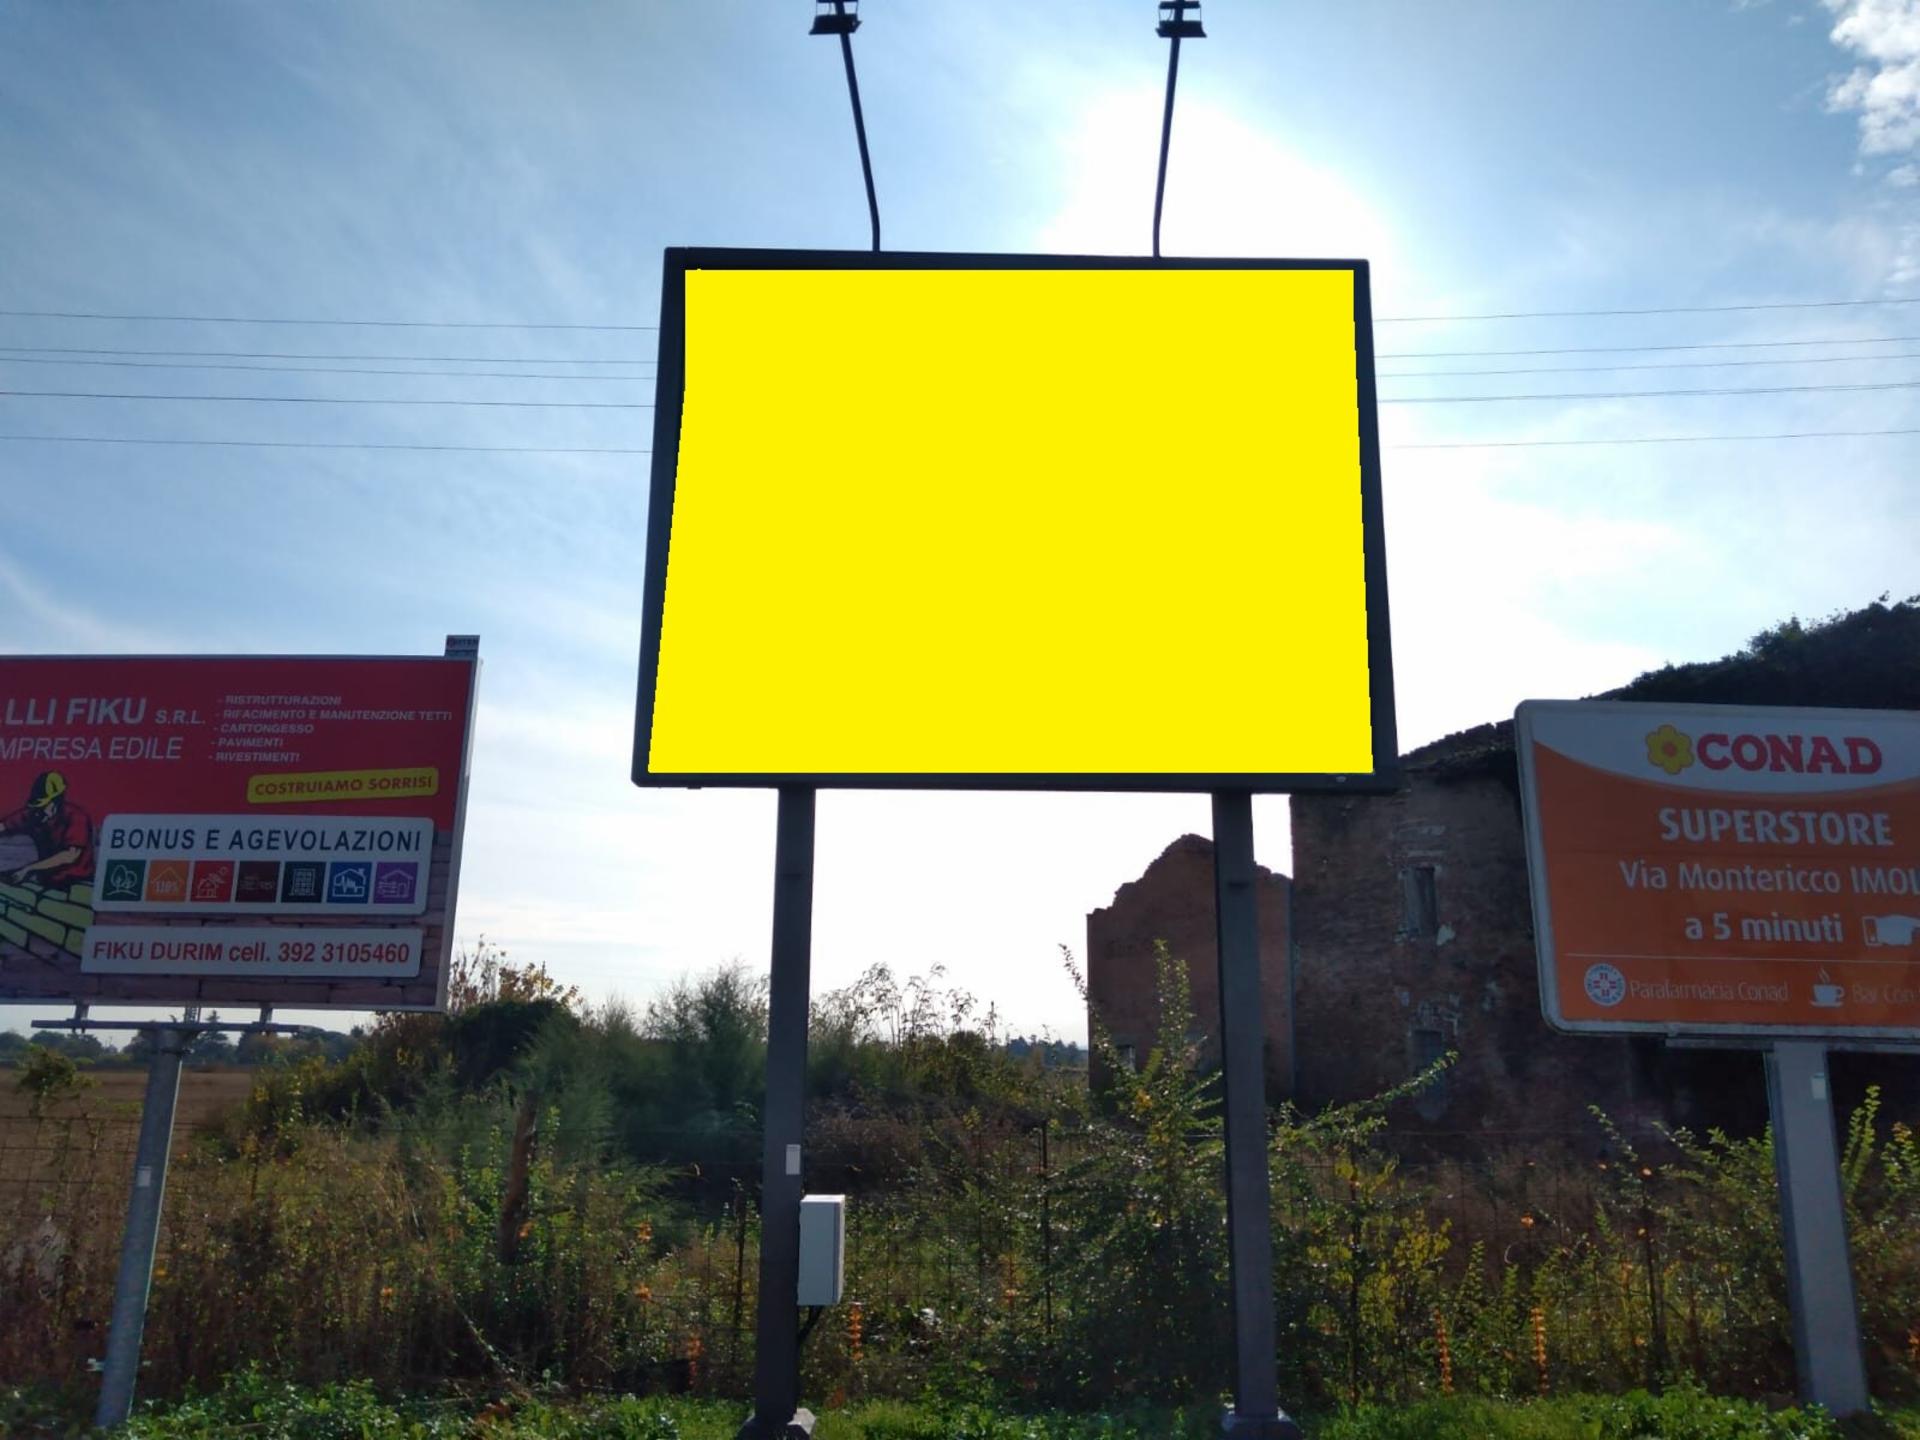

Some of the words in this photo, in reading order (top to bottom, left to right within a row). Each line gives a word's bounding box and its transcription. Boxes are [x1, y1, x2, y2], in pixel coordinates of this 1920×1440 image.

[0, 698, 56, 725] LLI
[65, 697, 147, 725] FIKU
[154, 708, 207, 725] S.R.L.
[224, 695, 342, 706] RISTRUTTURAZIONI
[223, 709, 306, 720] RIFACIMENTO
[309, 710, 317, 720] E
[320, 710, 416, 721] MANUTENZIONE
[419, 711, 453, 721] TETTI
[219, 723, 315, 734] CARTONGESSO
[0, 736, 101, 760] MPRESA
[108, 737, 183, 760] EDILE
[217, 737, 284, 748] PAVIMENTI
[1697, 733, 1883, 775] CONAD
[214, 752, 301, 763] RIVESTIMENTI
[254, 777, 364, 796] COSTRUIAMO
[368, 776, 433, 791] SORRISI
[1658, 808, 1893, 846] SUPERSTORE
[110, 828, 195, 850] BONUS
[205, 829, 221, 850] E
[229, 829, 422, 852] AGEVOLAZIONI
[1619, 860, 1667, 888] Via
[1679, 863, 1840, 893] Montericco
[1685, 917, 1703, 940] a
[1713, 913, 1731, 941] 5
[1742, 912, 1844, 943] minuti
[92, 941, 143, 960] FIKU
[150, 942, 222, 961] DURIM
[228, 942, 271, 963] cell.
[278, 943, 315, 963] 392
[321, 944, 410, 964] 3105460
[1738, 982, 1789, 1002] Conad
